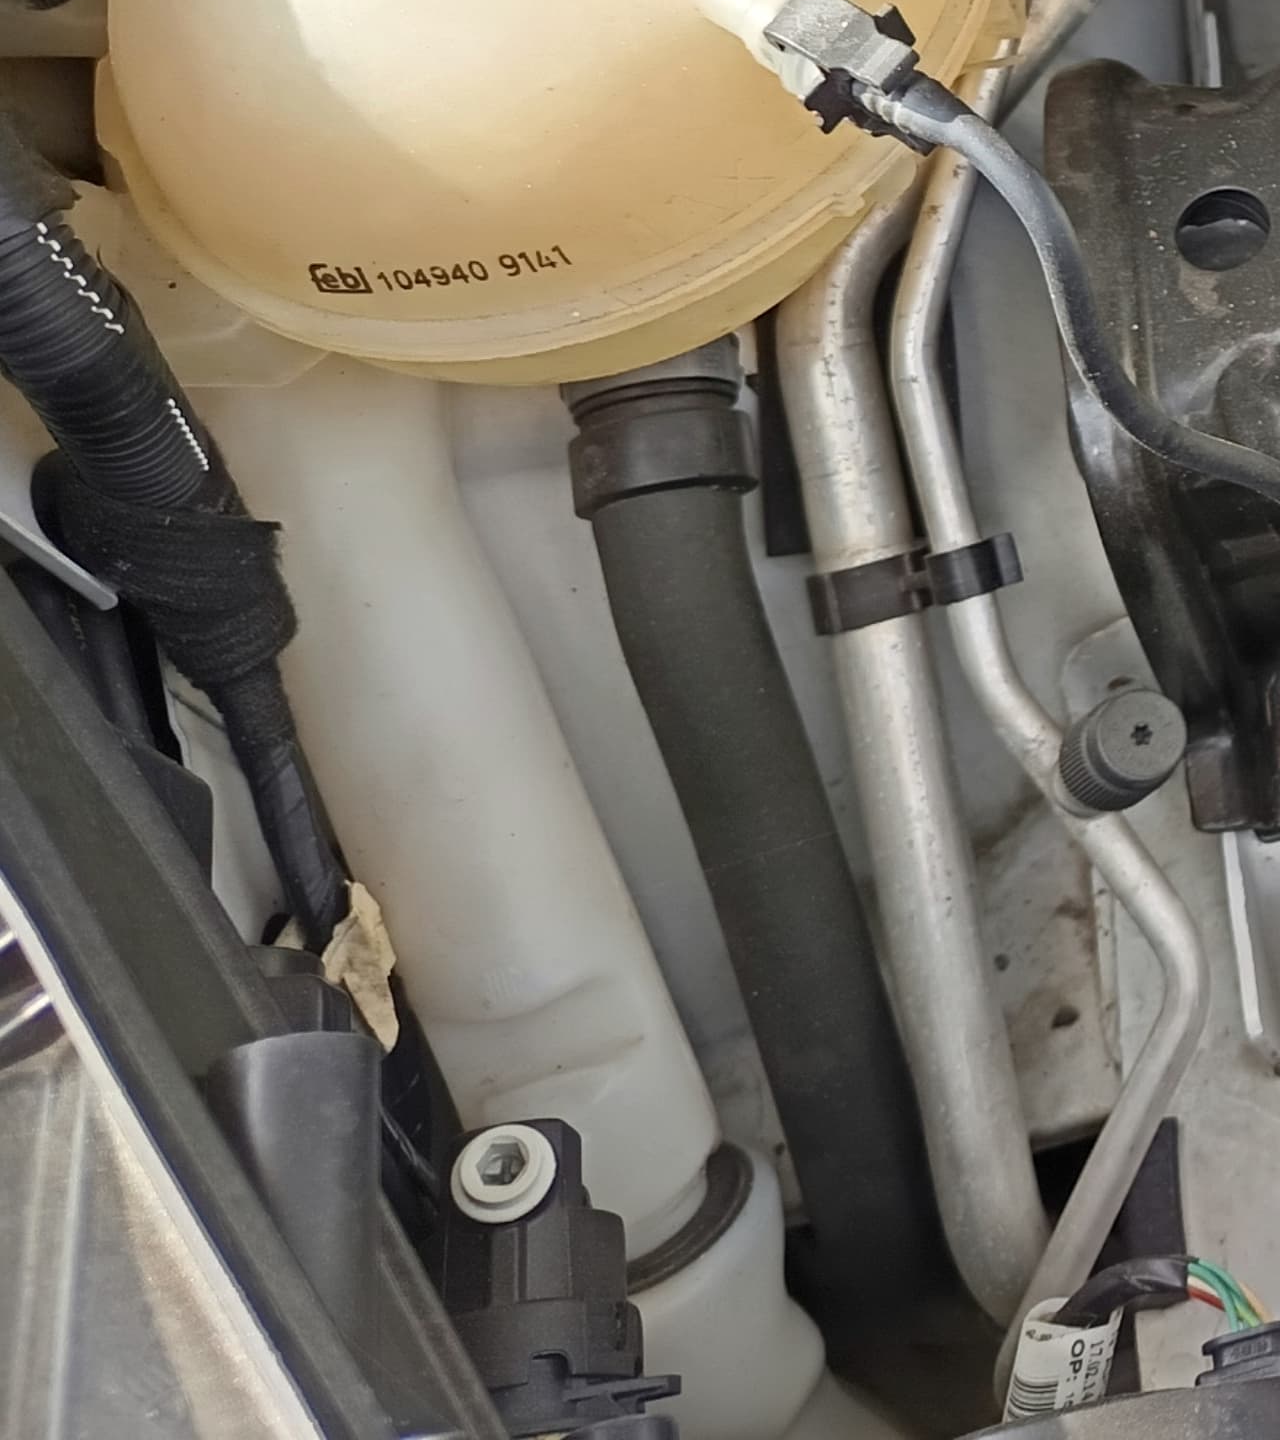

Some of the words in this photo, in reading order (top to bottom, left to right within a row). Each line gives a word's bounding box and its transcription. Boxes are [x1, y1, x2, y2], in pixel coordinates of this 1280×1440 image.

[377, 260, 489, 291] 104940
[498, 245, 572, 277] 9141
[1066, 1339, 1085, 1383] OP:
